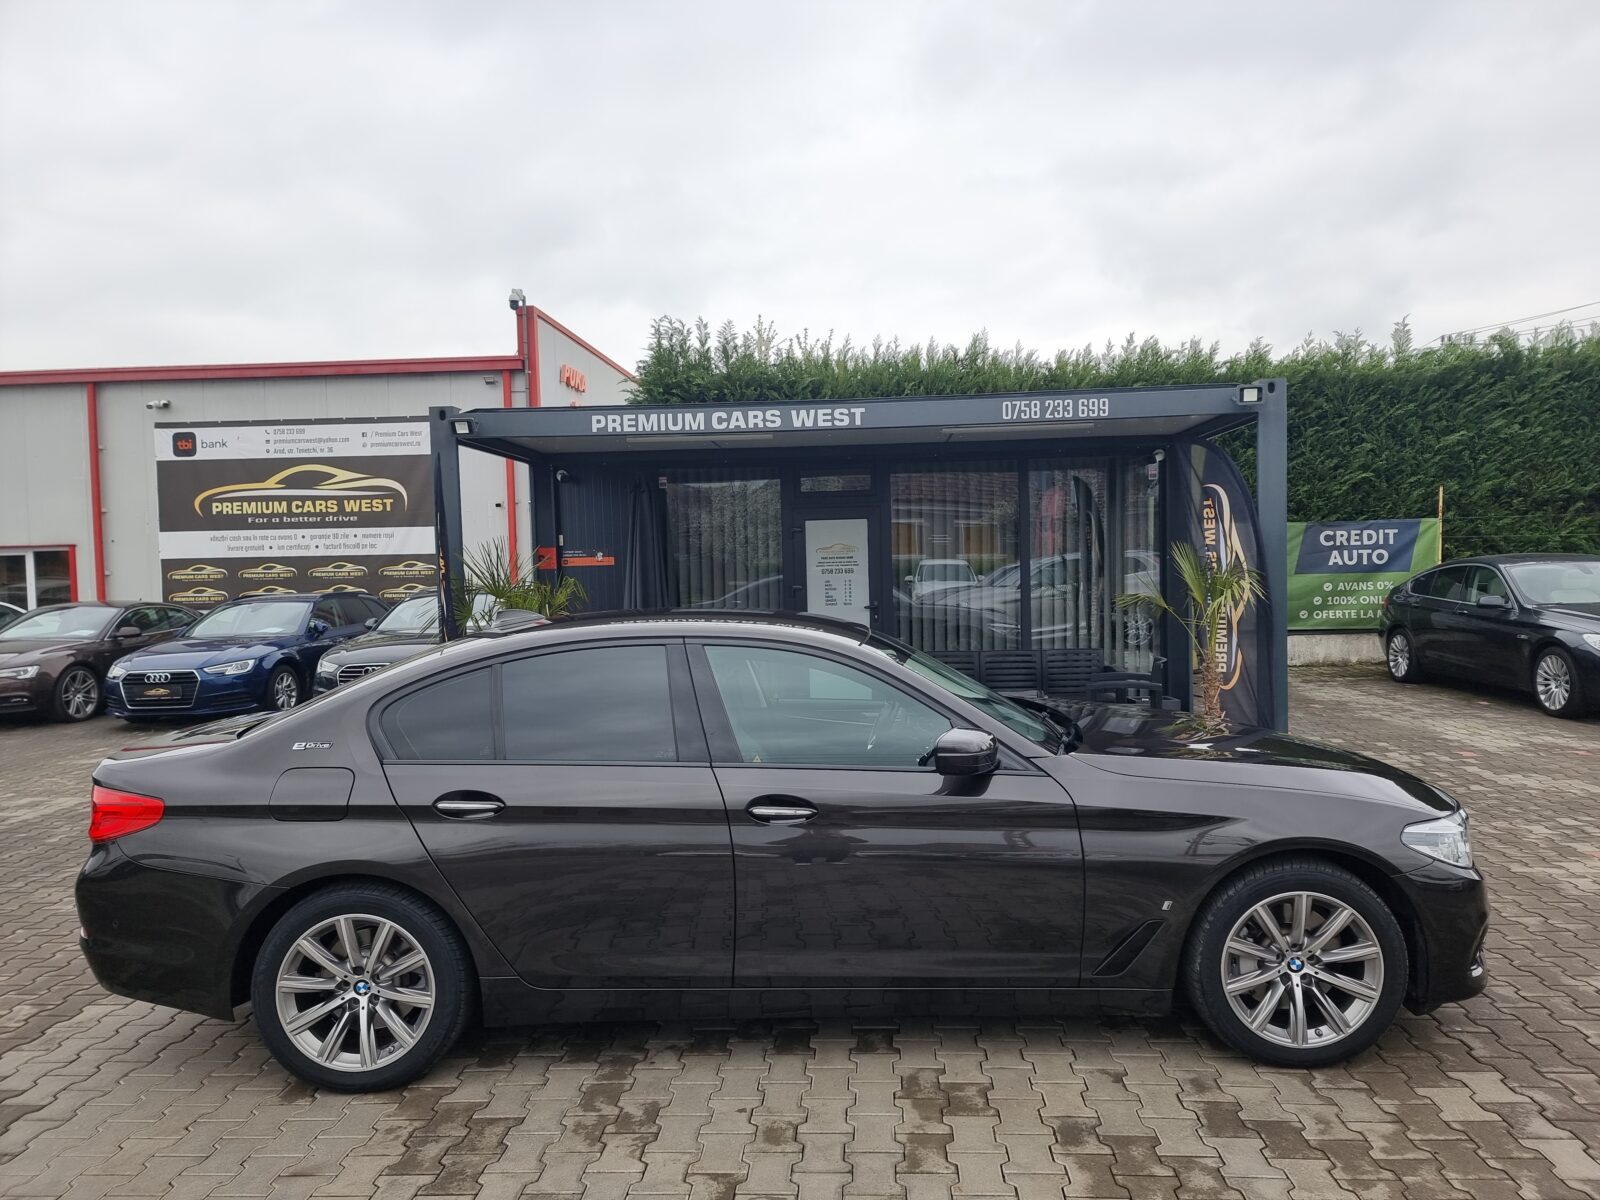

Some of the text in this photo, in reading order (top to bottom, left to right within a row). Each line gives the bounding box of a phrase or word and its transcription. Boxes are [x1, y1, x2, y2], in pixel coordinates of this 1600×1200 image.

[1002, 398, 1109, 420] 0758 233 699
[591, 407, 866, 433] PREMIUM CARS WEST
[176, 439, 228, 450] tbi bank
[212, 499, 394, 514] PREMIUM CARS WEST
[1319, 529, 1398, 546] CREDIT
[1328, 549, 1389, 566] AUTO
[1338, 582, 1374, 591] AVANS
[1327, 595, 1384, 605] 100% ONL
[1313, 610, 1357, 619] OFERTE
[1360, 609, 1374, 619] LA
